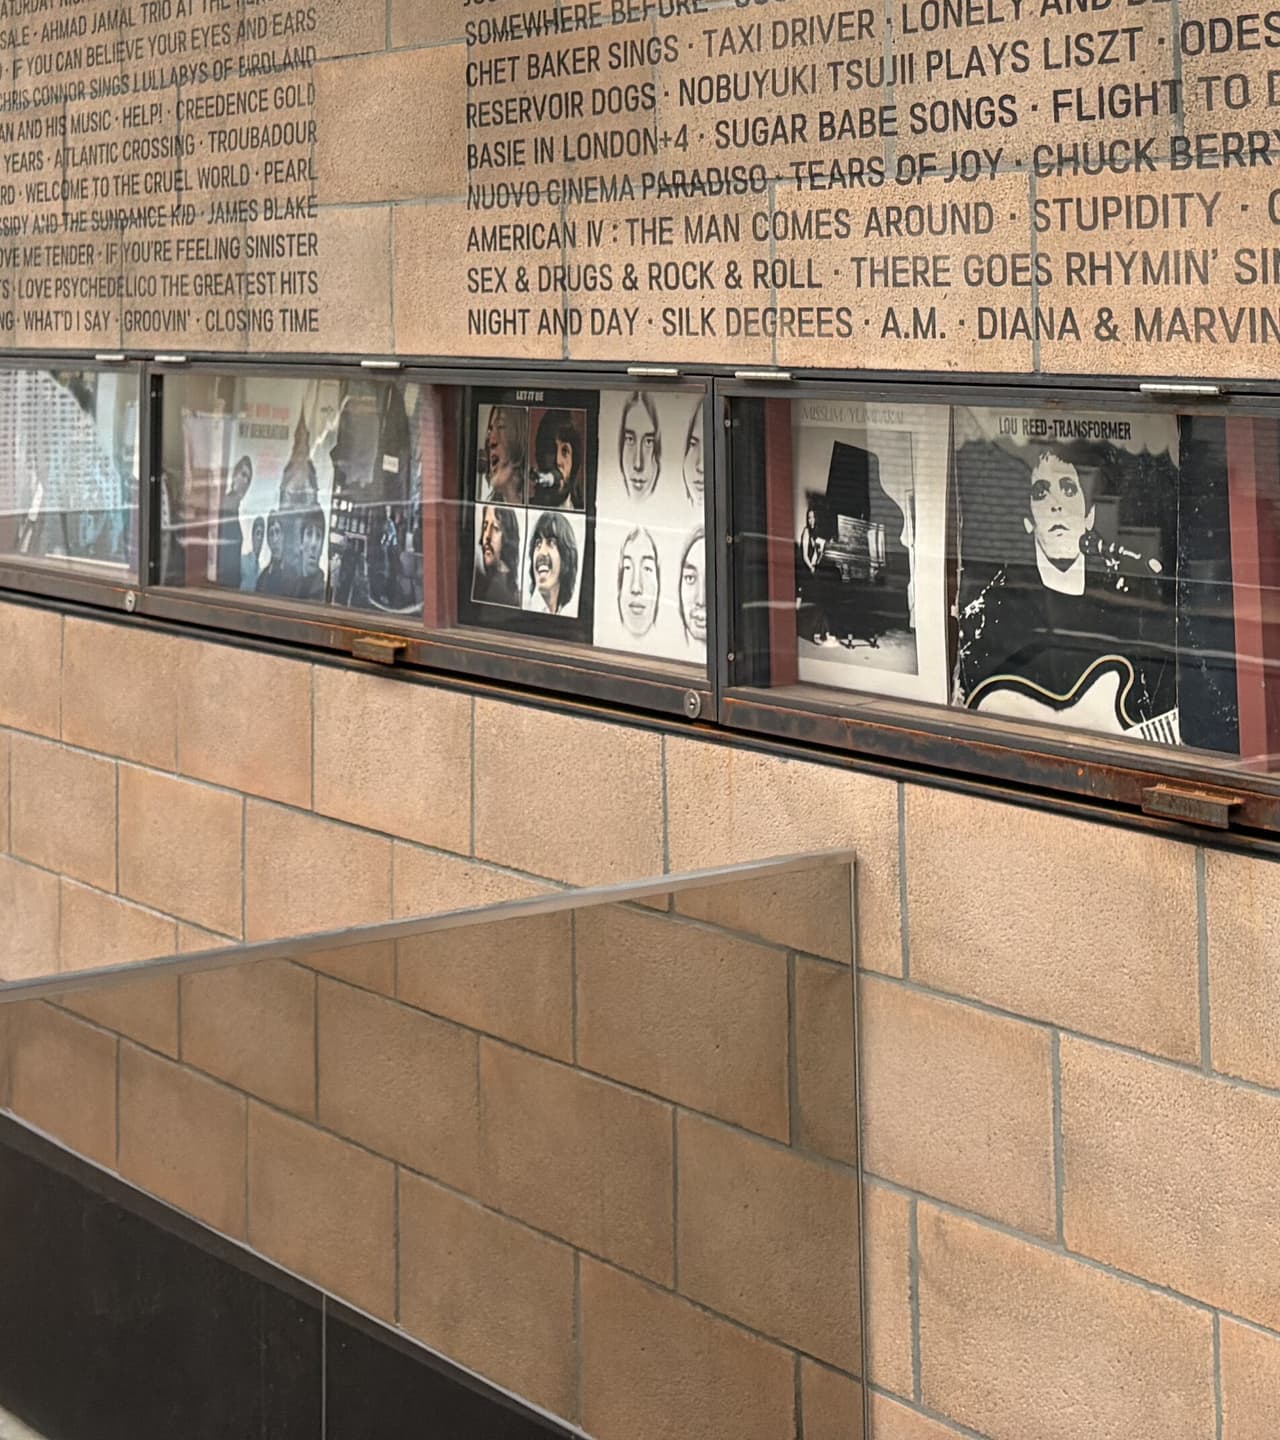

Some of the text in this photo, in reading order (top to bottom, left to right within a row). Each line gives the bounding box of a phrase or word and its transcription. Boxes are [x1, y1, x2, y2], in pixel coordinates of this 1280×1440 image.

[40, 14, 87, 43] AHMAD
[91, 5, 136, 34] JAMAL
[465, 55, 520, 88] CHET
[527, 44, 600, 80] BAKER
[608, 33, 678, 70] SINGS
[702, 23, 761, 58] TAXI
[771, 7, 874, 50] DRIVER
[467, 138, 525, 169] BASIE
[533, 136, 554, 164] IN
[563, 123, 688, 162] LONDON+4
[714, 112, 807, 149] SUGAR
[818, 104, 898, 142] BABE
[909, 93, 1017, 135] SONGS
[1052, 78, 1185, 123] FLIGHT
[1194, 72, 1250, 112] TO
[53, 119, 318, 169] ATLANTIC CROSSING TROUBADOUR
[25, 177, 88, 203] WELCOME
[92, 175, 109, 198] TO
[113, 173, 139, 197] THE
[144, 168, 193, 194] CRUEL
[197, 163, 249, 190] WORLD
[264, 156, 318, 184] PEARL
[54, 275, 155, 298] PSYCHEDELICO
[160, 273, 190, 297] THE
[193, 271, 275, 296] GREATEST
[280, 270, 318, 295] HITS
[76, 310, 79, 331] I
[83, 310, 109, 331] SAY
[204, 308, 273, 332] CLOSING
[279, 308, 319, 332] TIME
[467, 308, 530, 335] NIGHT
[537, 308, 582, 335] AND
[590, 308, 638, 336] DAY
[661, 307, 715, 336] SILK
[725, 307, 852, 338] DEGREES
[880, 307, 945, 339] A.M.
[977, 306, 1080, 340] DIANA
[1093, 307, 1119, 341] &
[998, 416, 1131, 440] LOU REED-TRANSFORMER
